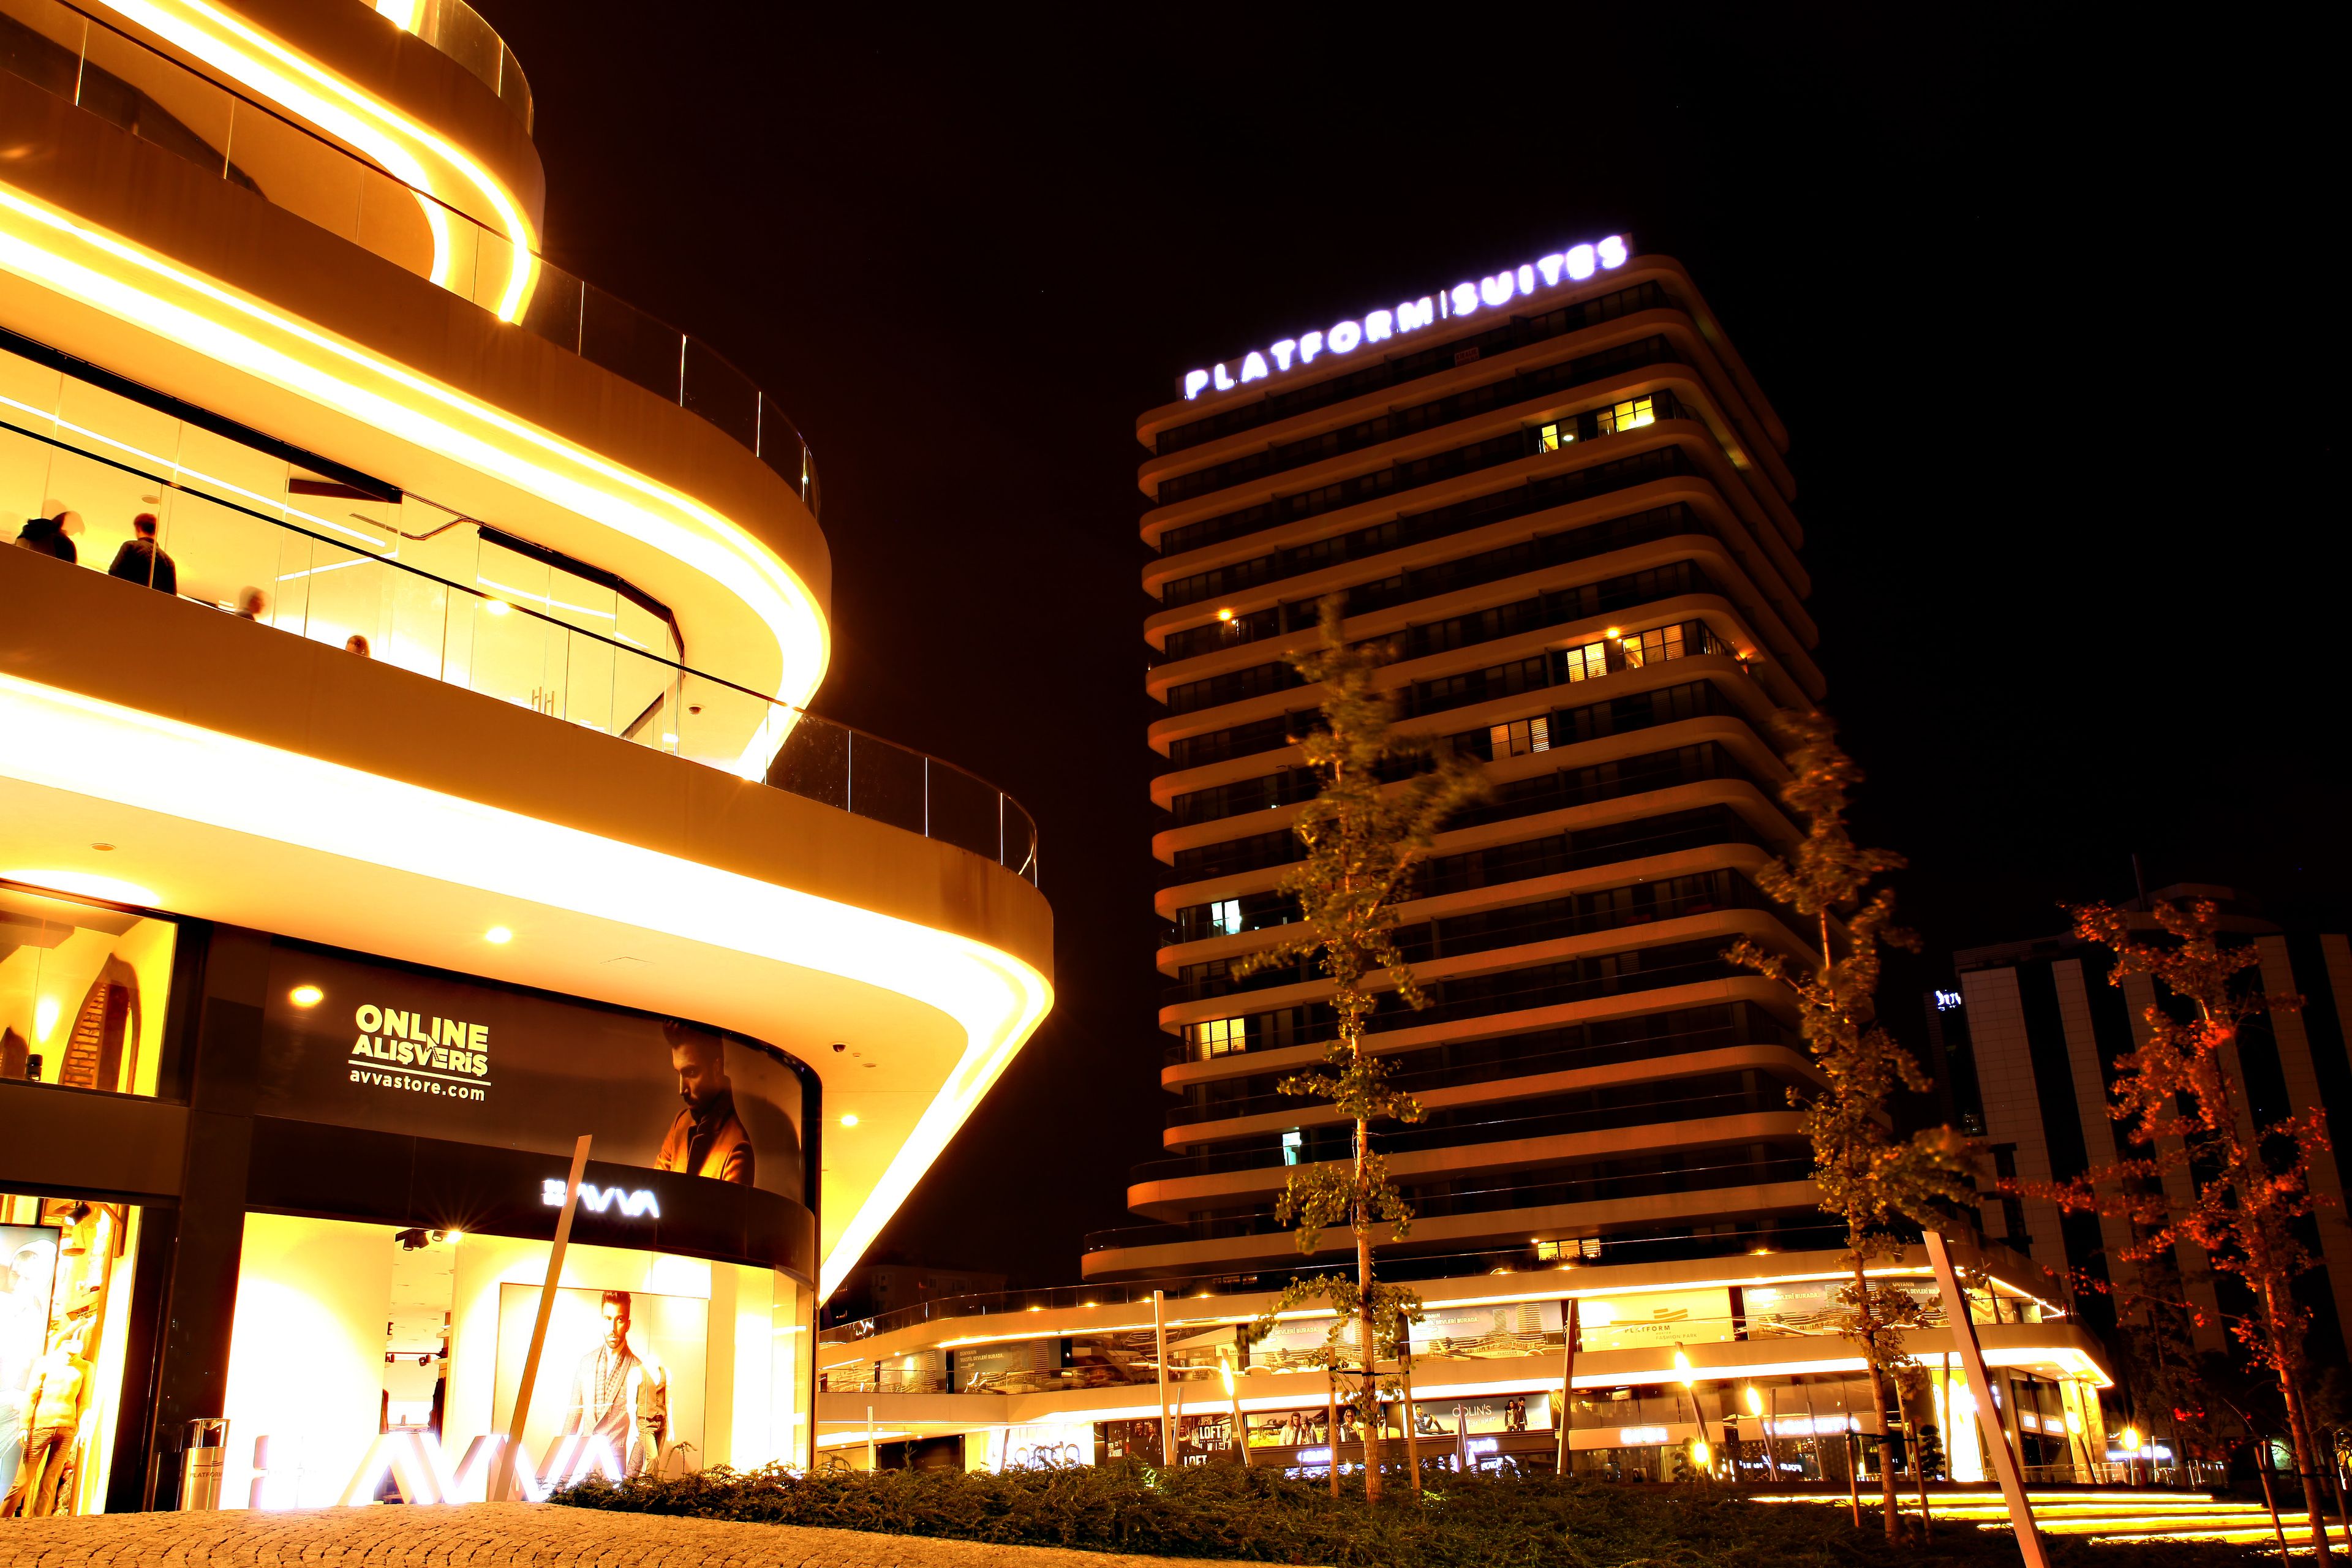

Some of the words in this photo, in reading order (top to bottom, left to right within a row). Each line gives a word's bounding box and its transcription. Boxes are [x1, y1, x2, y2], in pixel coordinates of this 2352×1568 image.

[1185, 296, 1433, 400] PLATFORM
[1452, 235, 1627, 316] SUITES
[356, 1004, 489, 1052] ONLINE
[352, 1034, 489, 1077] ALIŞVERİŞ
[350, 1070, 485, 1101] avvastore.com
[1184, 1455, 1207, 1468] LOFT
